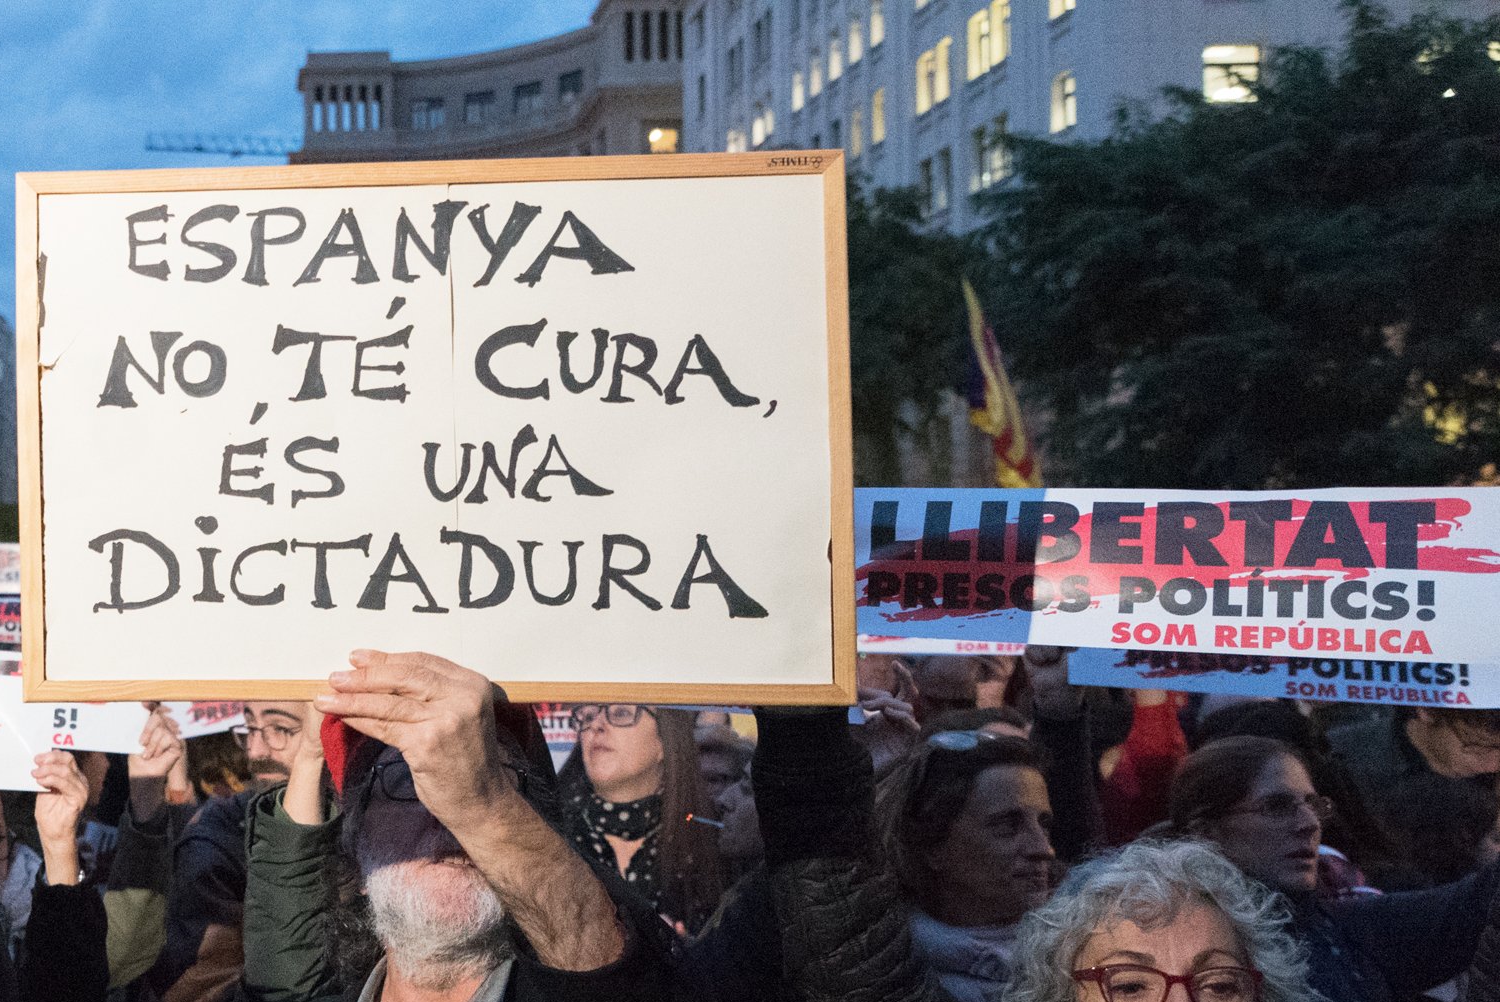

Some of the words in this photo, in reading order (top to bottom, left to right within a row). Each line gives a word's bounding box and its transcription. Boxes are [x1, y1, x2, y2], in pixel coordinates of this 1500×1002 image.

[127, 200, 635, 287] ESPANYA
[97, 331, 228, 408] NO
[272, 297, 414, 403] TÉ
[475, 318, 778, 418] CURA,
[219, 402, 347, 508] ÉS
[422, 424, 614, 503] UNA
[870, 500, 1437, 570] LLIBERTAT
[866, 571, 1091, 613] PRESOS
[1117, 566, 1436, 621] POLÍTICS!
[1111, 623, 1197, 648] SOM
[1214, 620, 1434, 655] REPÚBLICA
[1284, 681, 1338, 697] SOM
